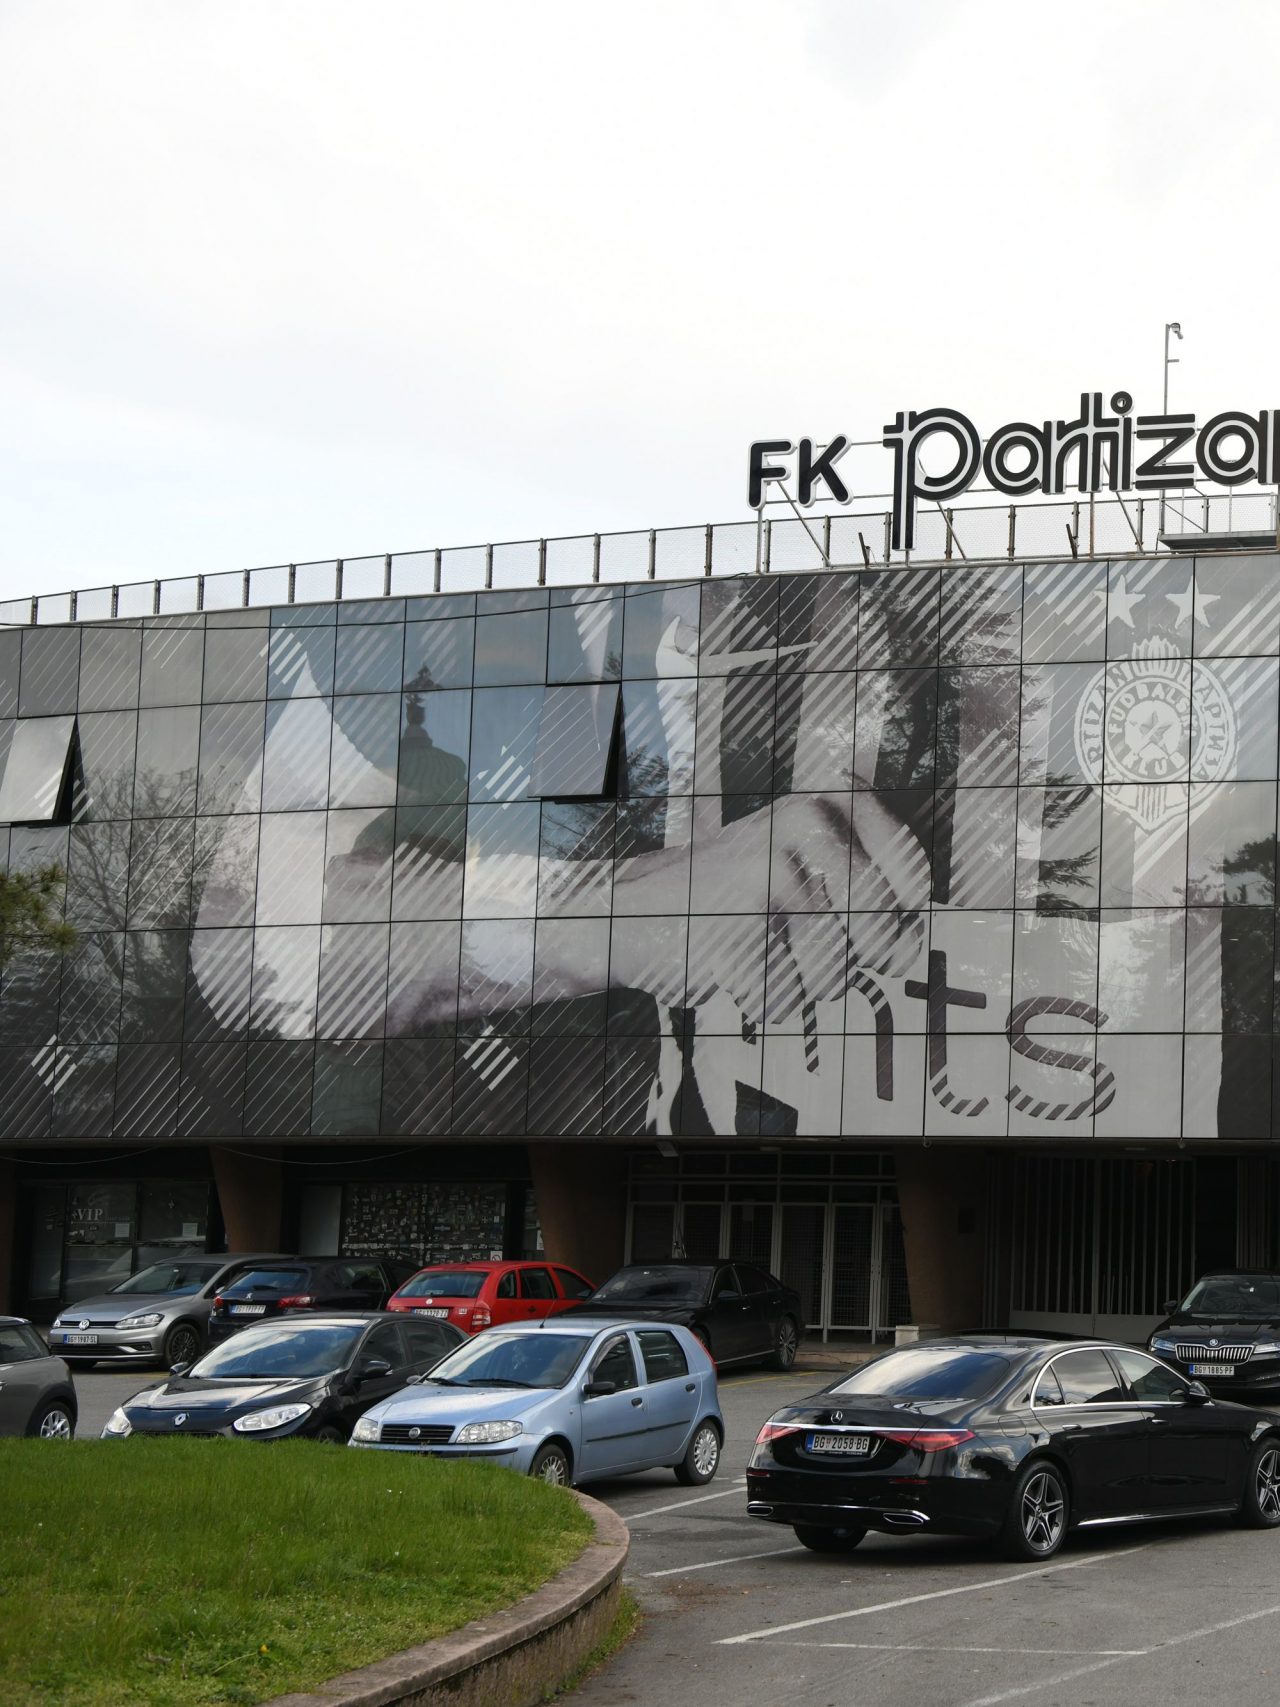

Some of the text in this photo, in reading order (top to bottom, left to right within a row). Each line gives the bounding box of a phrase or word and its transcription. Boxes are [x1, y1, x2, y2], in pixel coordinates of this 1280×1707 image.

[748, 434, 853, 511] FK
[1194, 1365, 1203, 1374] BG
[813, 1435, 825, 1449] BG
